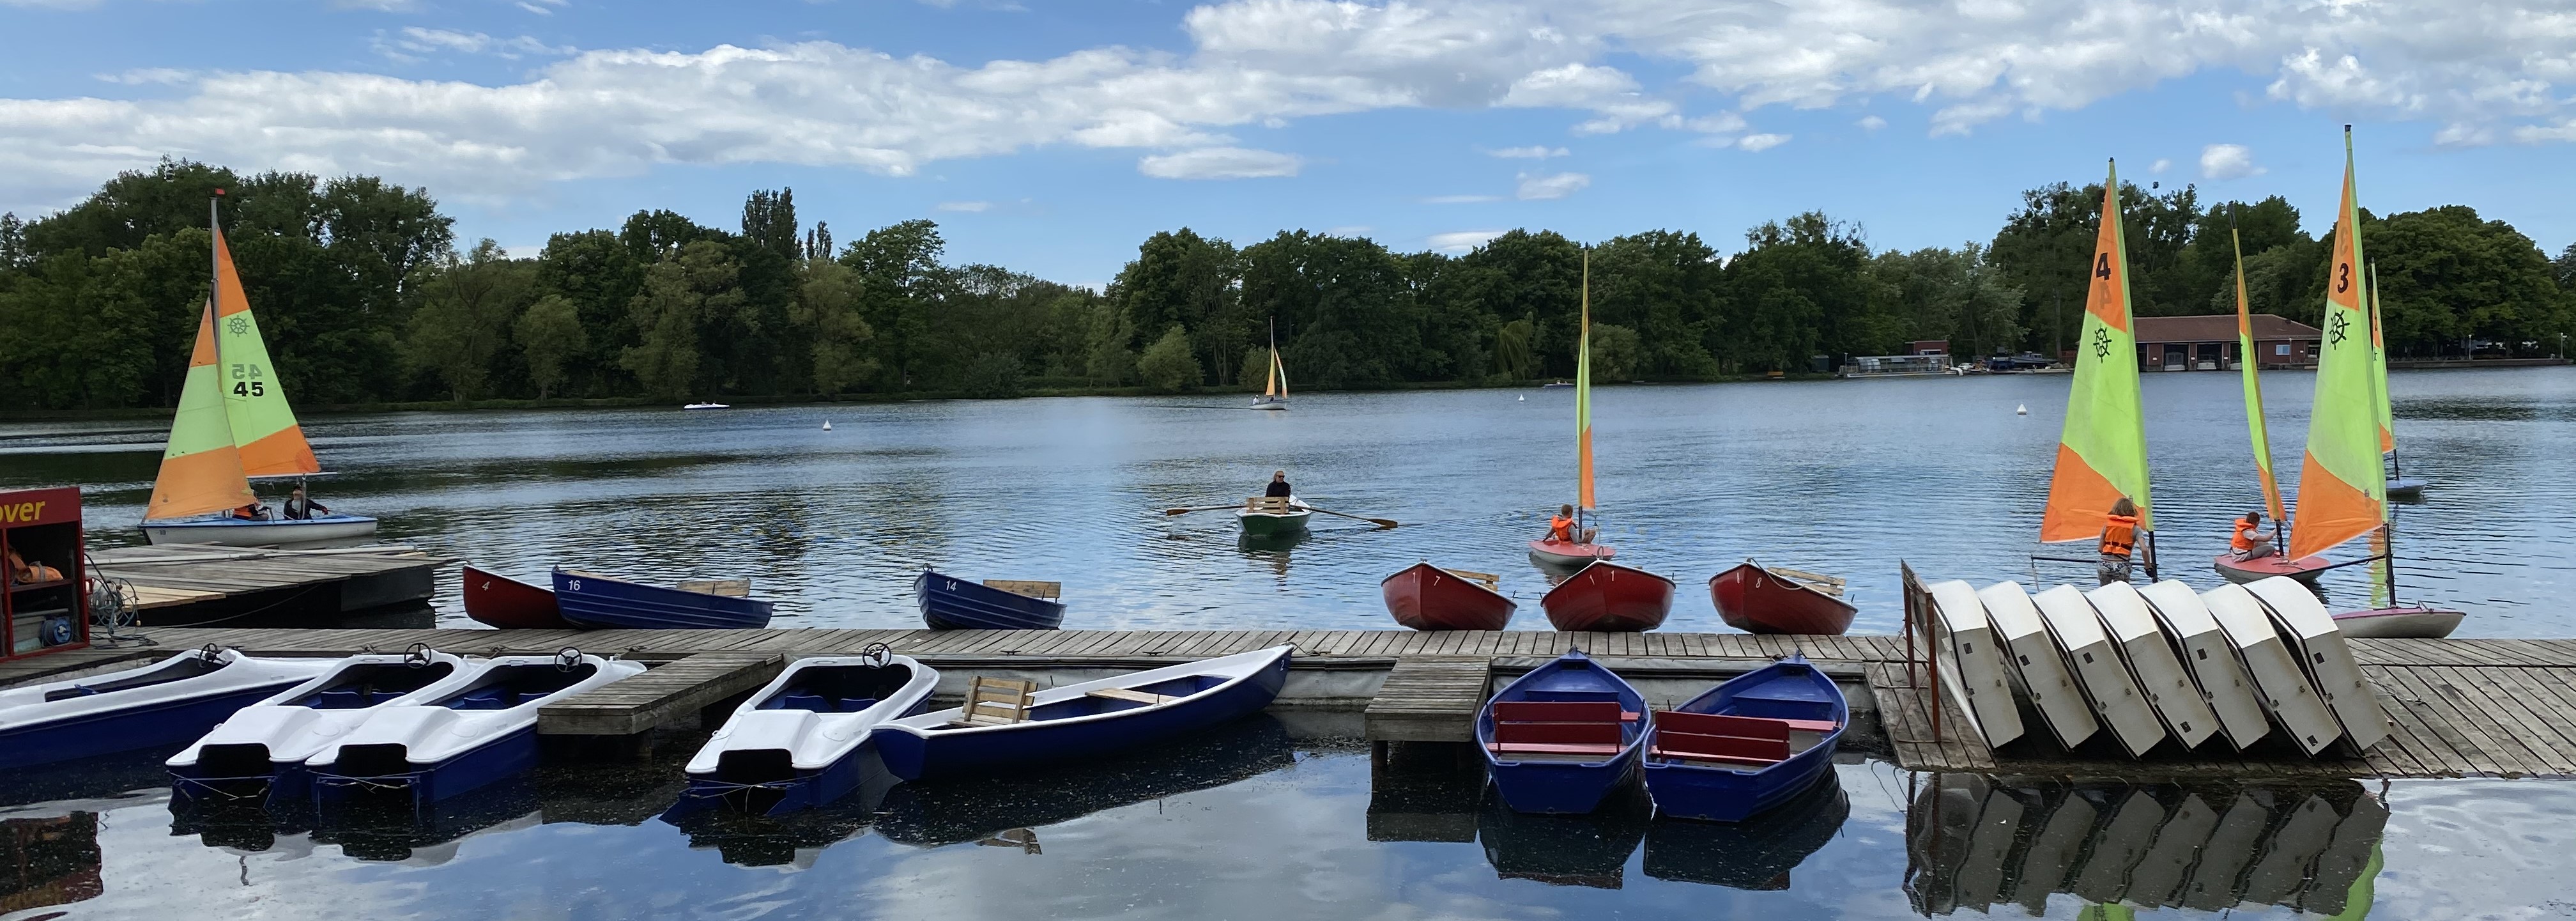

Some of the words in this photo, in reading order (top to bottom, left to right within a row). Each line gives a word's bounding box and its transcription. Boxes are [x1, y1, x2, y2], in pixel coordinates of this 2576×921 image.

[2096, 252, 2111, 281] 4
[2338, 263, 2349, 293] 3
[233, 382, 263, 397] 45
[0, 500, 45, 523] ver
[1433, 575, 1441, 586] 7
[1611, 570, 1614, 582] 1
[481, 581, 491, 591] 4
[568, 580, 581, 591] 16
[946, 580, 957, 592] 14
[1755, 577, 1762, 589] 8
[1280, 659, 1285, 671] 2
